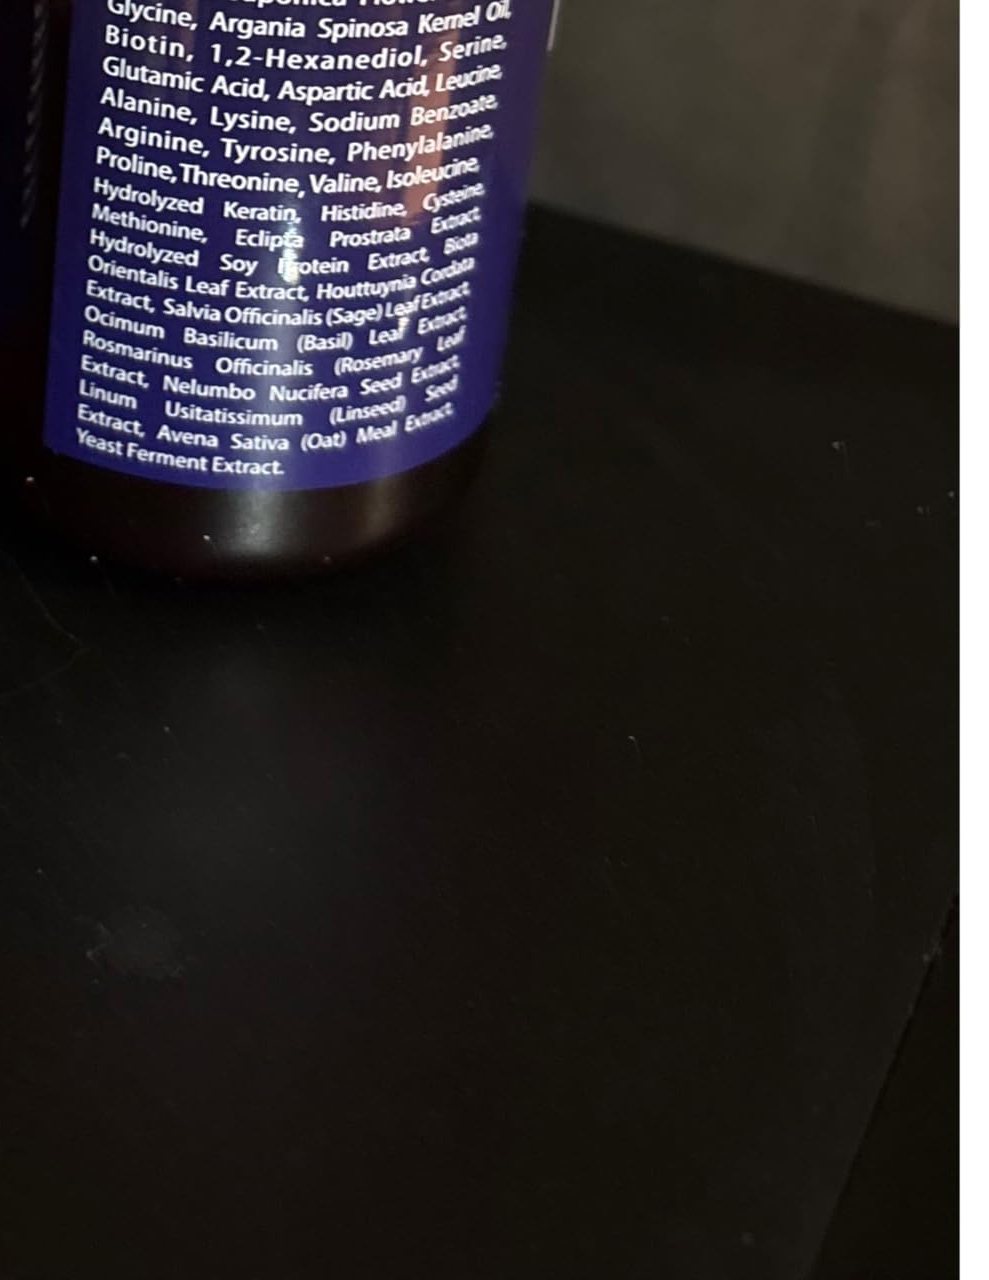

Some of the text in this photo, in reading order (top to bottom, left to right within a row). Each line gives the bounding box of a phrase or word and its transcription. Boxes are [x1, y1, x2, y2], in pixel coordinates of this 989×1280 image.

[105, 24, 194, 62] Biotin,
[211, 43, 428, 70] 1,2-Hexanediol,
[209, 11, 306, 40] Argania
[317, 18, 409, 44] Spinosa
[103, 56, 374, 106] Glutamic Acid, Aspartic
[100, 87, 401, 134] Alanine, Lysine, Sodium
[98, 117, 336, 165] Arginine, Tyrosine,
[94, 177, 205, 214] Hydrolyzed
[309, 173, 383, 194] Valine,
[92, 203, 411, 248] Methionine, Prostrata
[88, 255, 231, 296] Orientalis Leaf
[90, 228, 259, 277] Hydrolyzed Soy
[86, 279, 221, 322] Extract, Salvia
[84, 305, 279, 351] Ocimum Basilicum
[83, 329, 313, 376] Rosmarinus Officinalis
[81, 354, 256, 400] Extract, Nelumbo
[79, 379, 303, 426] Linum Usitatissimum
[78, 403, 290, 451] Extract, Avena Sativa
[127, 442, 208, 472] Ferment
